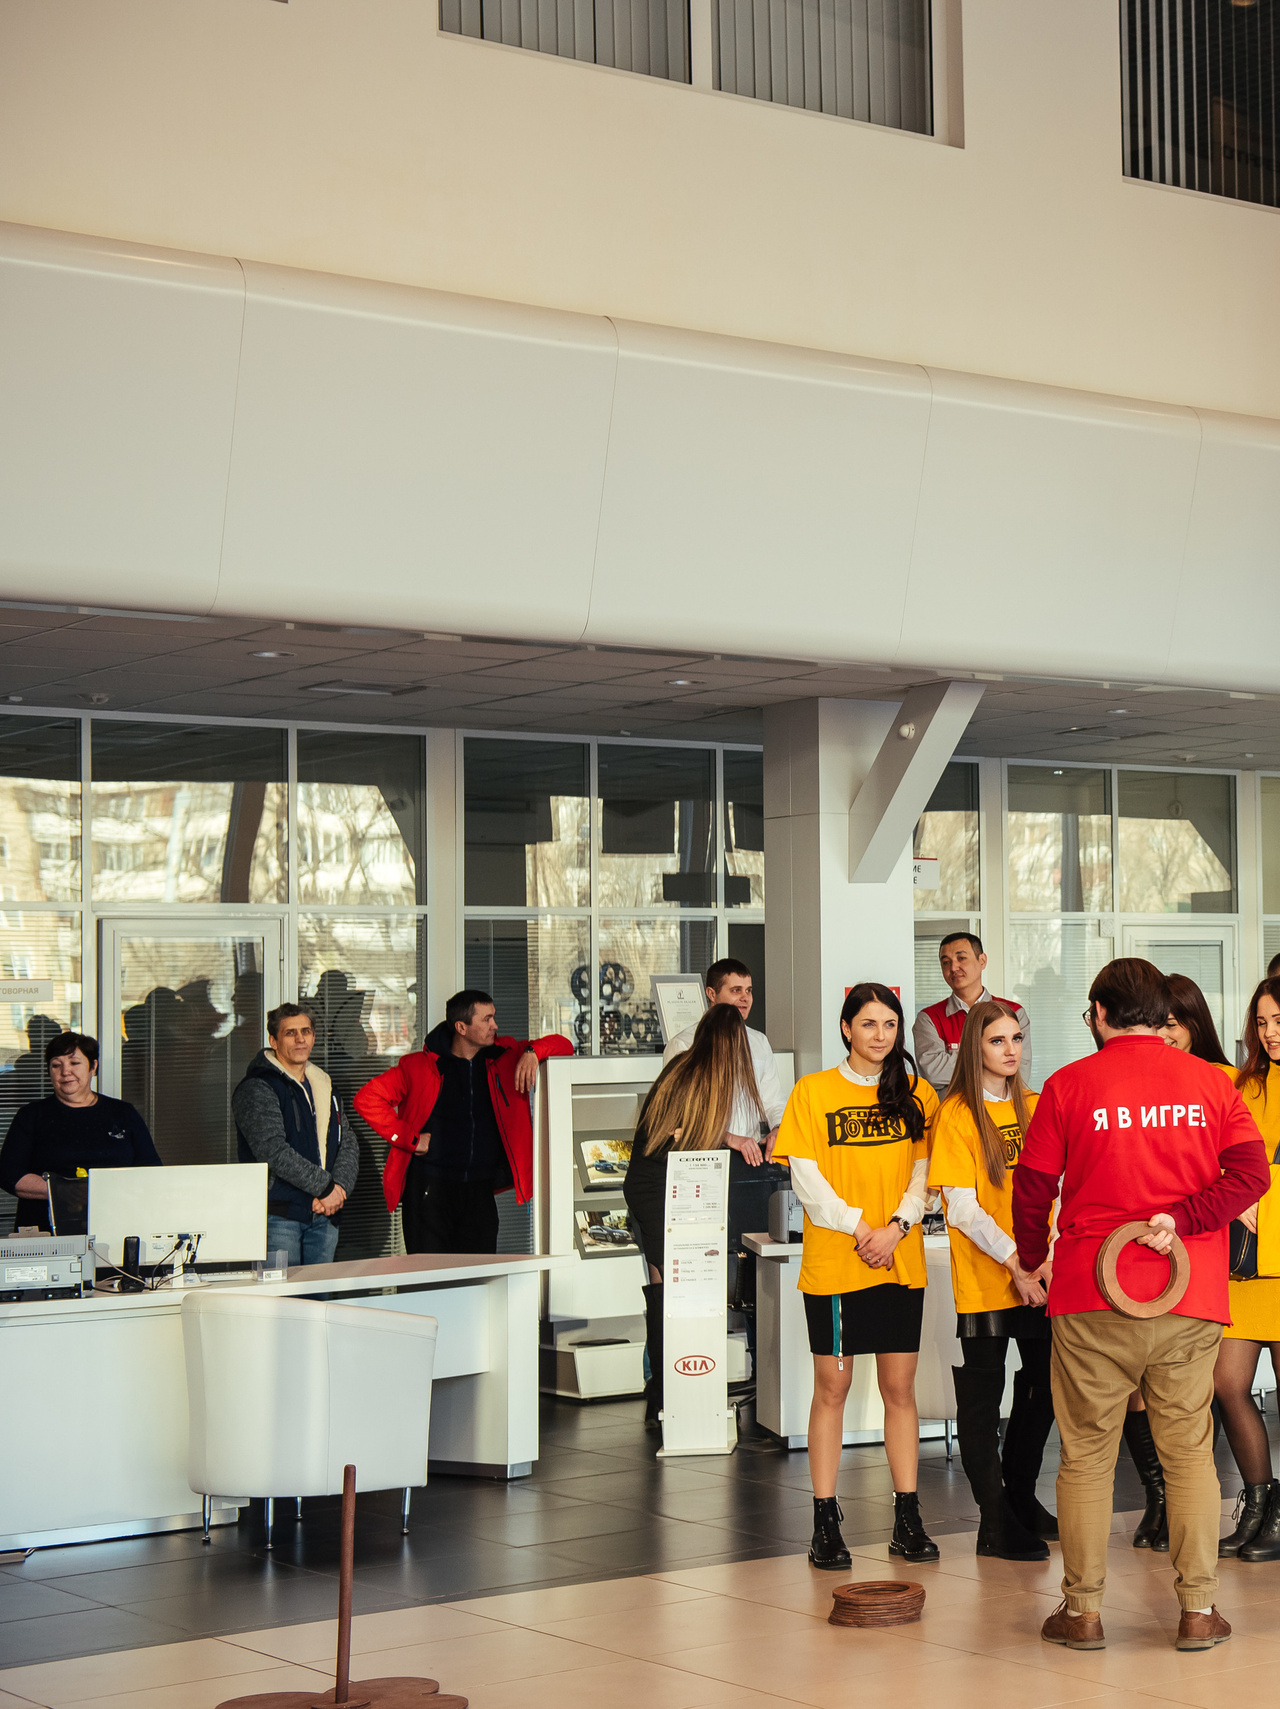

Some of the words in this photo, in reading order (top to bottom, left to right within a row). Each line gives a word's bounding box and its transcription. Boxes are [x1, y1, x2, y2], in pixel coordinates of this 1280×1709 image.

[0, 987, 39, 995] ОВОРНАЯ
[1093, 1108, 1109, 1131] Я
[1117, 1106, 1132, 1129] В
[1140, 1104, 1207, 1128] ИГРЕ!
[682, 1359, 709, 1371] KIA
